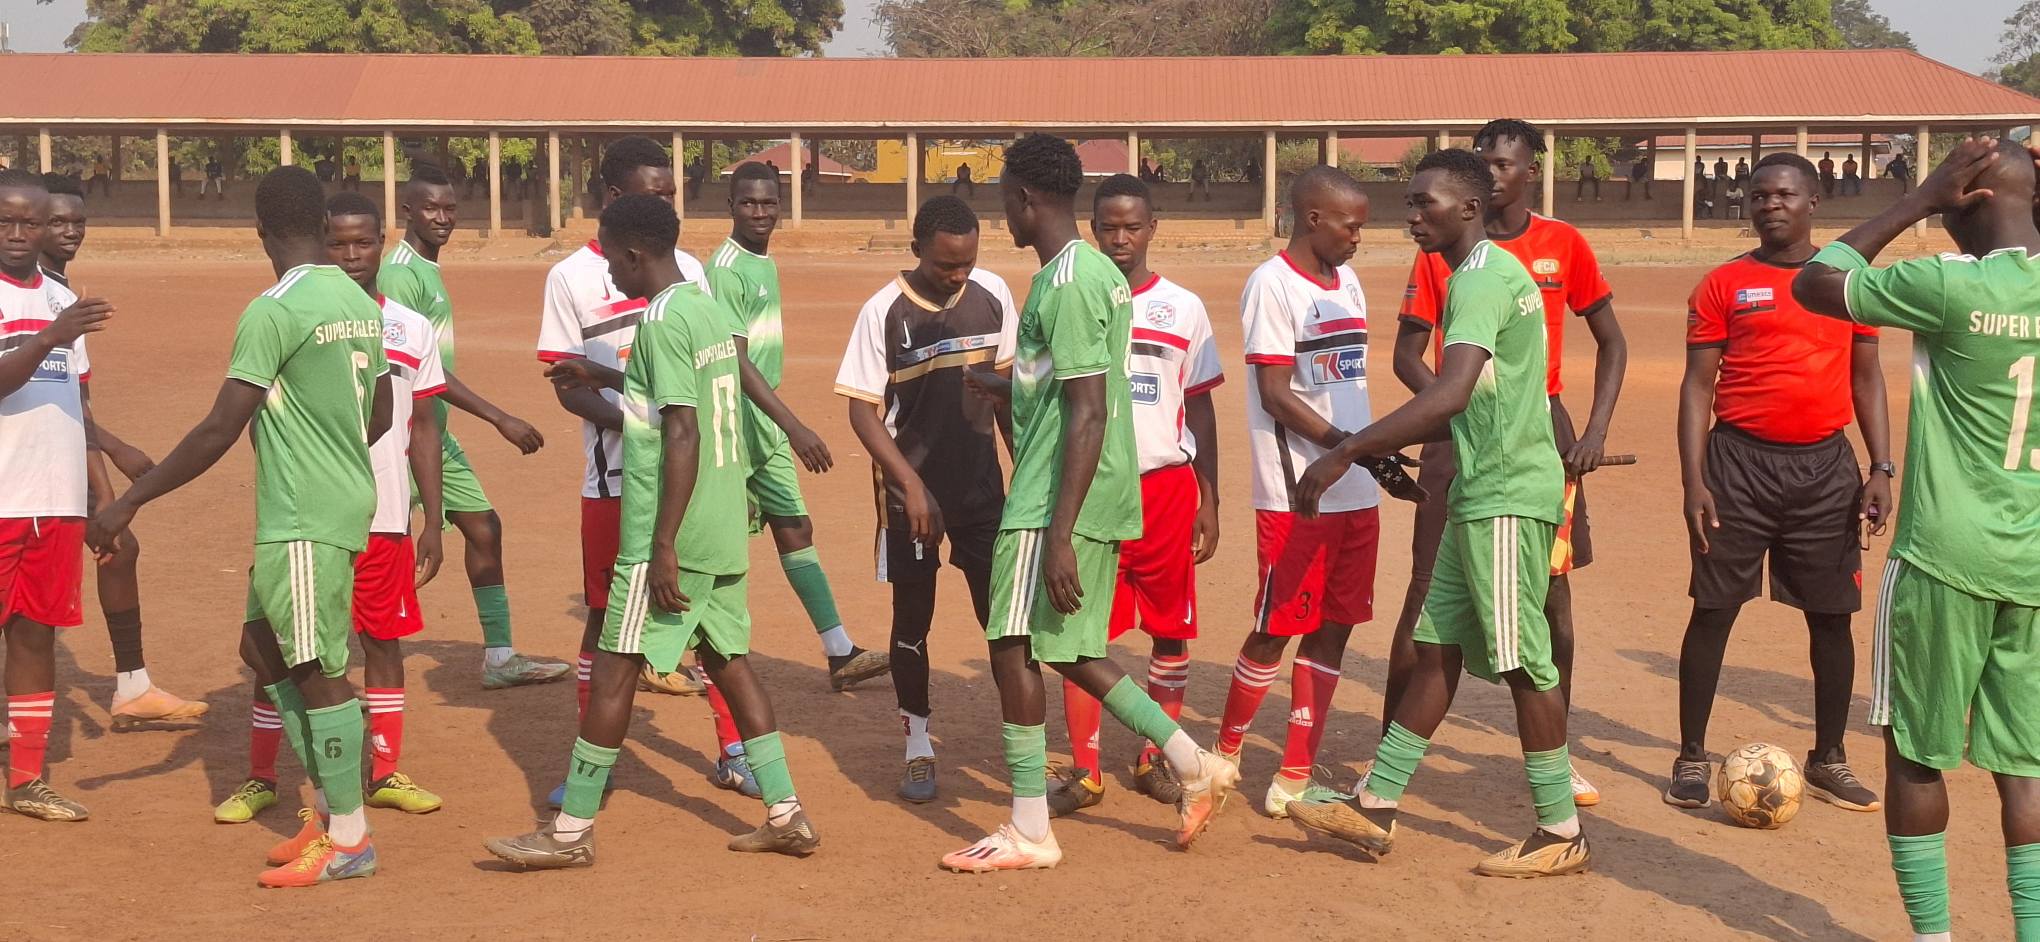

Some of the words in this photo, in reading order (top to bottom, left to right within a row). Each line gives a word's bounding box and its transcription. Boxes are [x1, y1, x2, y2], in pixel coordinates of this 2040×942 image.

[1968, 310, 2030, 338] SUPER
[42, 359, 67, 372] ORTS
[1131, 382, 1157, 395] ORTS
[712, 373, 738, 468] 17
[1296, 591, 1312, 620] 3
[324, 736, 343, 759] 6
[577, 760, 600, 778] 17
